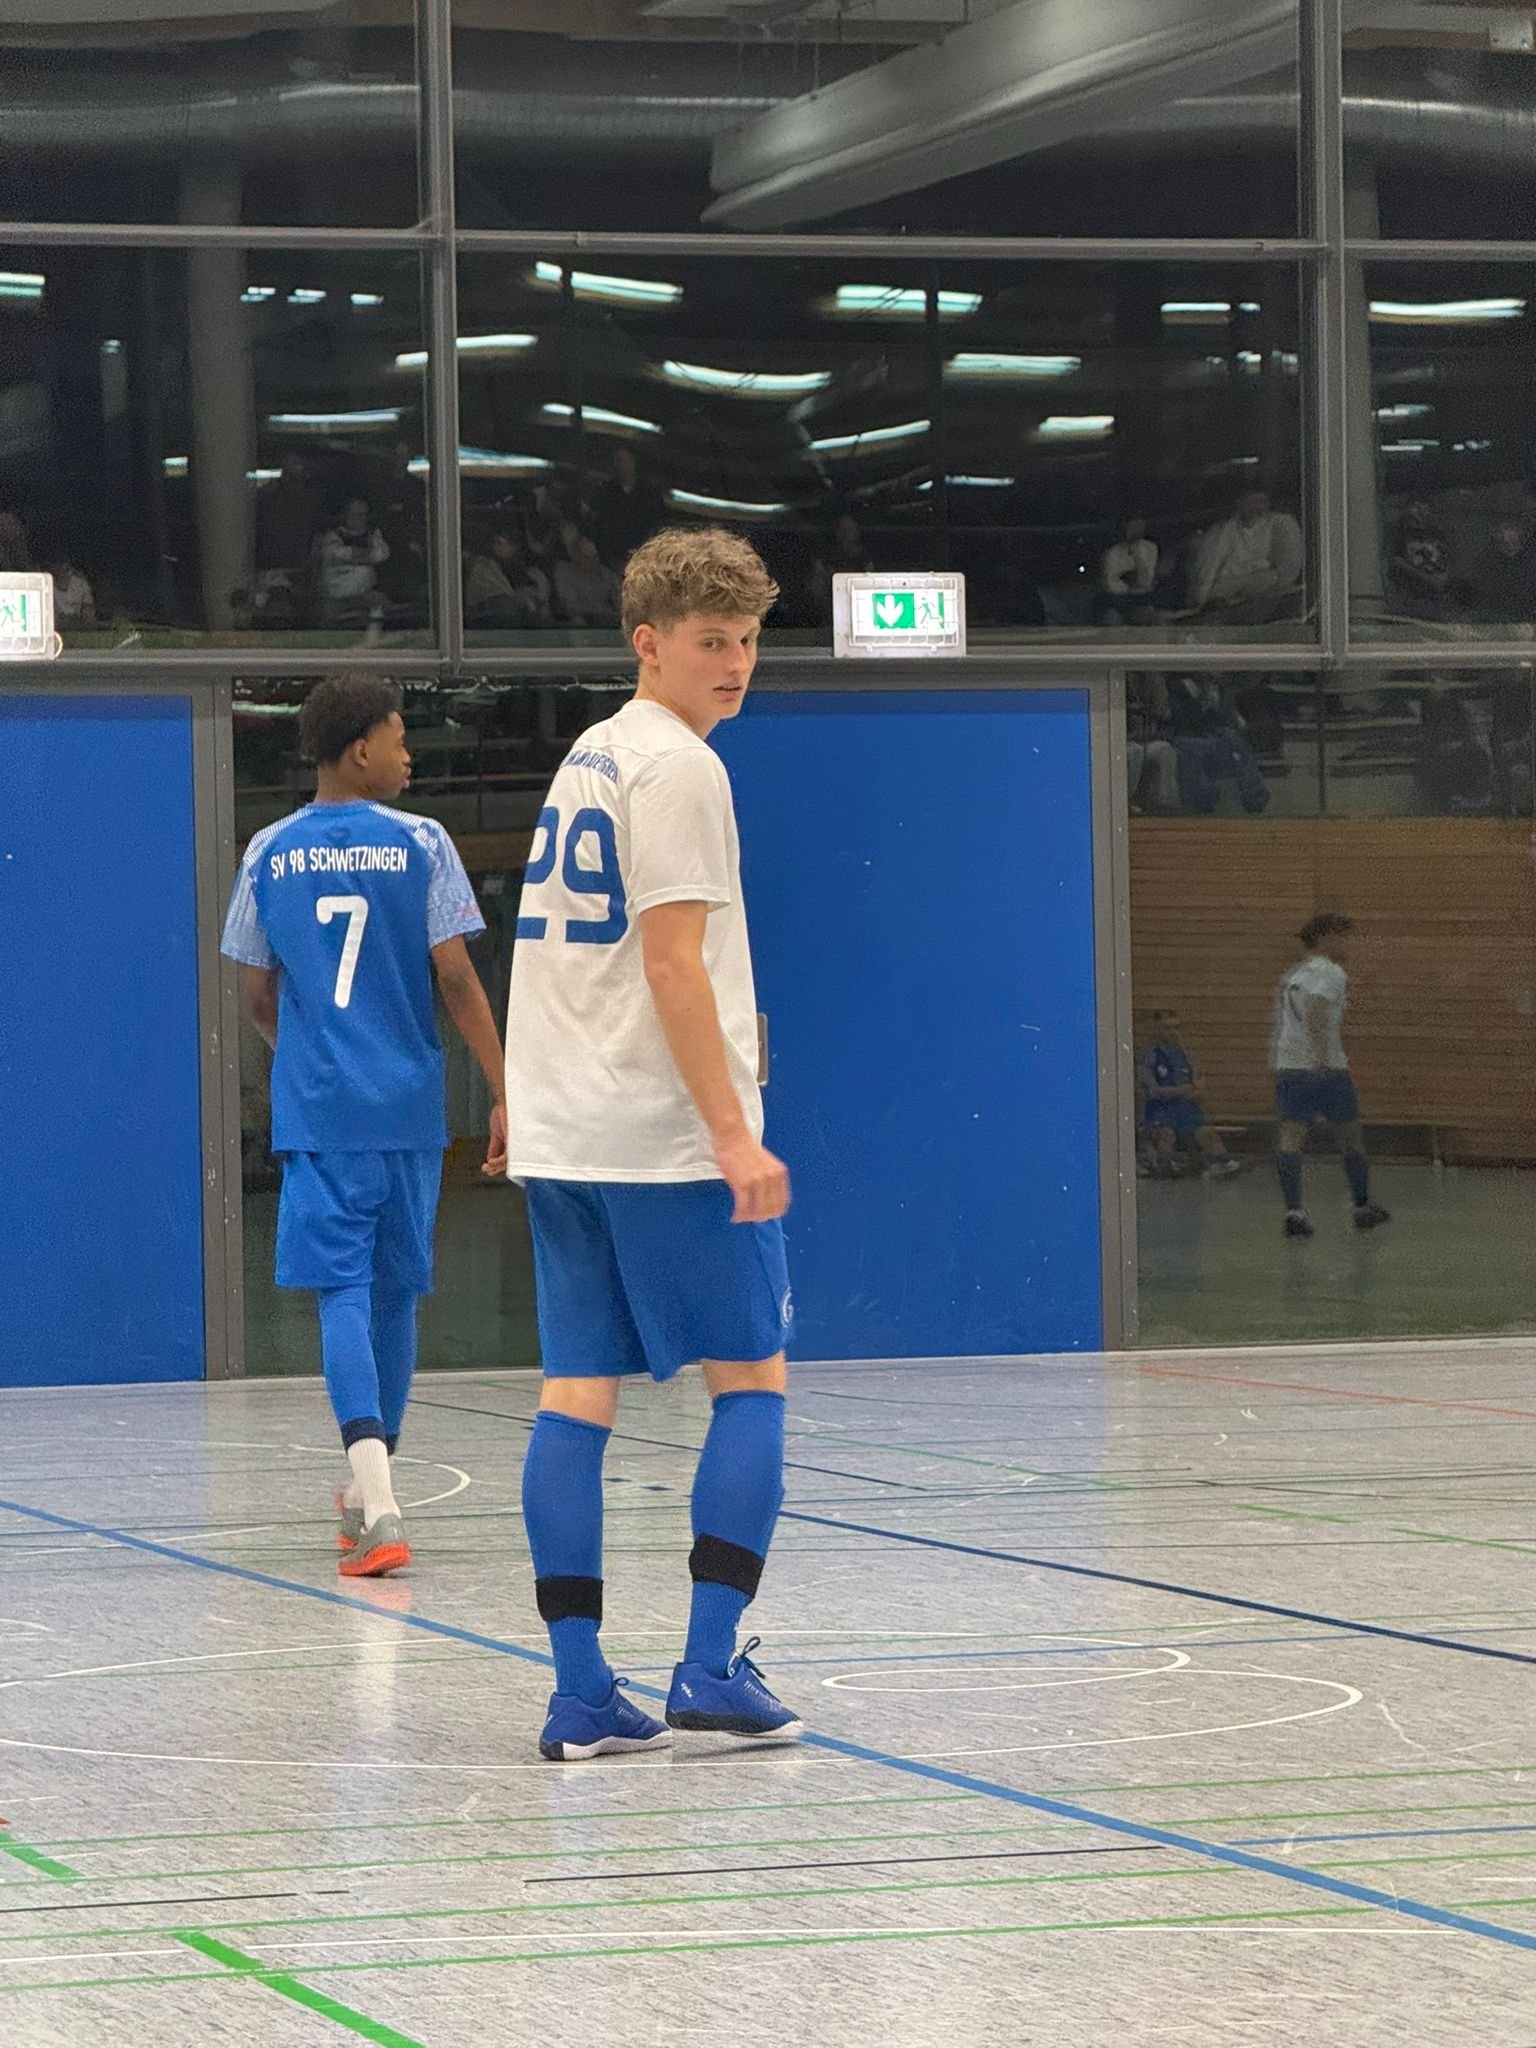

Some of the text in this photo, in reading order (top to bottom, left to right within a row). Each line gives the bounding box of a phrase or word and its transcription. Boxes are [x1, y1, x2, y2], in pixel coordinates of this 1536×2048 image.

[270, 845, 408, 881] SV 98 SCHWETZINGEN
[316, 895, 369, 1009] 7
